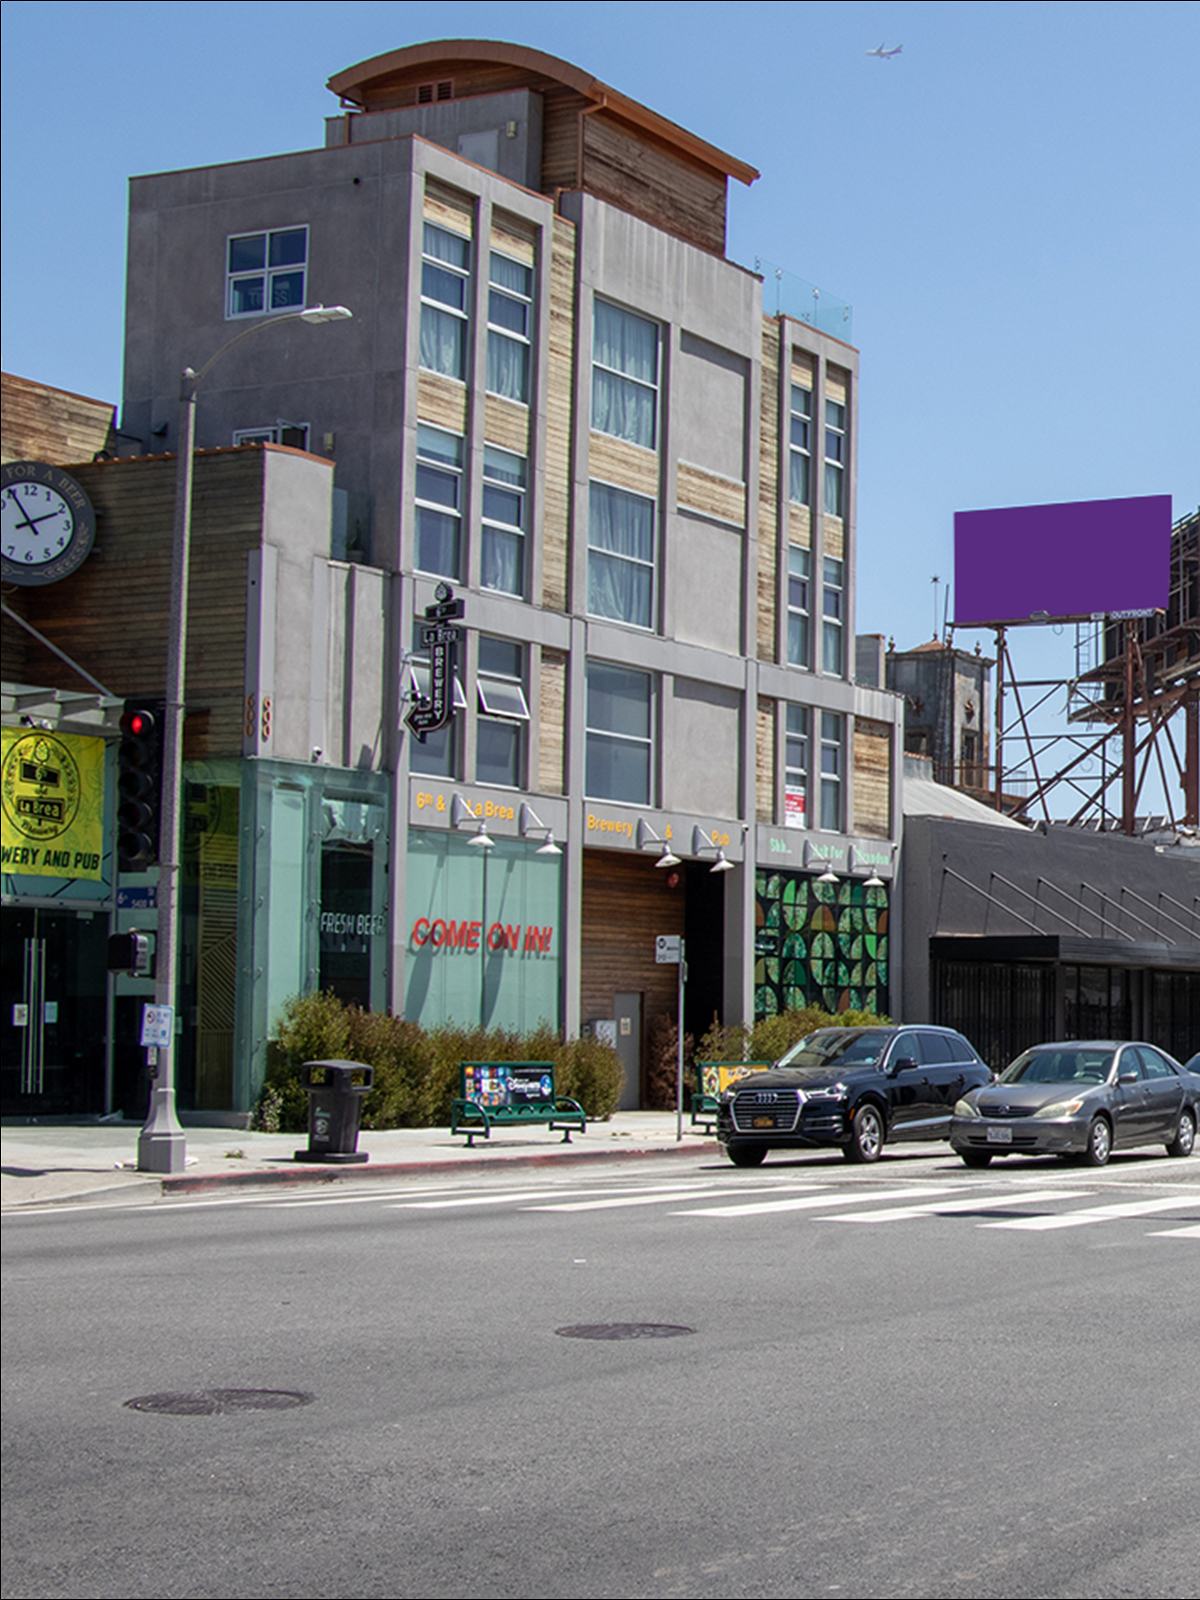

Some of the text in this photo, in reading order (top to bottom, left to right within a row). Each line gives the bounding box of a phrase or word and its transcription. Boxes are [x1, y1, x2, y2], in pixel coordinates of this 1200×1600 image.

[6, 464, 86, 510] FOR A BEER
[24, 485, 38, 497] 12
[44, 490, 52, 502] 1
[57, 502, 67, 514] 2
[62, 519, 71, 531] 3
[56, 536, 65, 548] 4
[7, 545, 15, 557] 7
[24, 550, 33, 563] 6
[43, 547, 51, 560] 5
[423, 628, 458, 644] La Brea
[433, 646, 445, 720] BREWERY
[243, 692, 255, 738] 600
[262, 694, 273, 738] 600
[20, 800, 60, 818] La Brea
[416, 791, 434, 809] 6th
[435, 793, 446, 813] &
[485, 800, 515, 821] Brea
[587, 815, 731, 847] Brewery & Pub
[43, 849, 71, 867] AND
[74, 852, 100, 870] PUB
[829, 844, 844, 860] for
[320, 911, 386, 935] FRESH BEER
[412, 916, 554, 952] COME ON IN!
